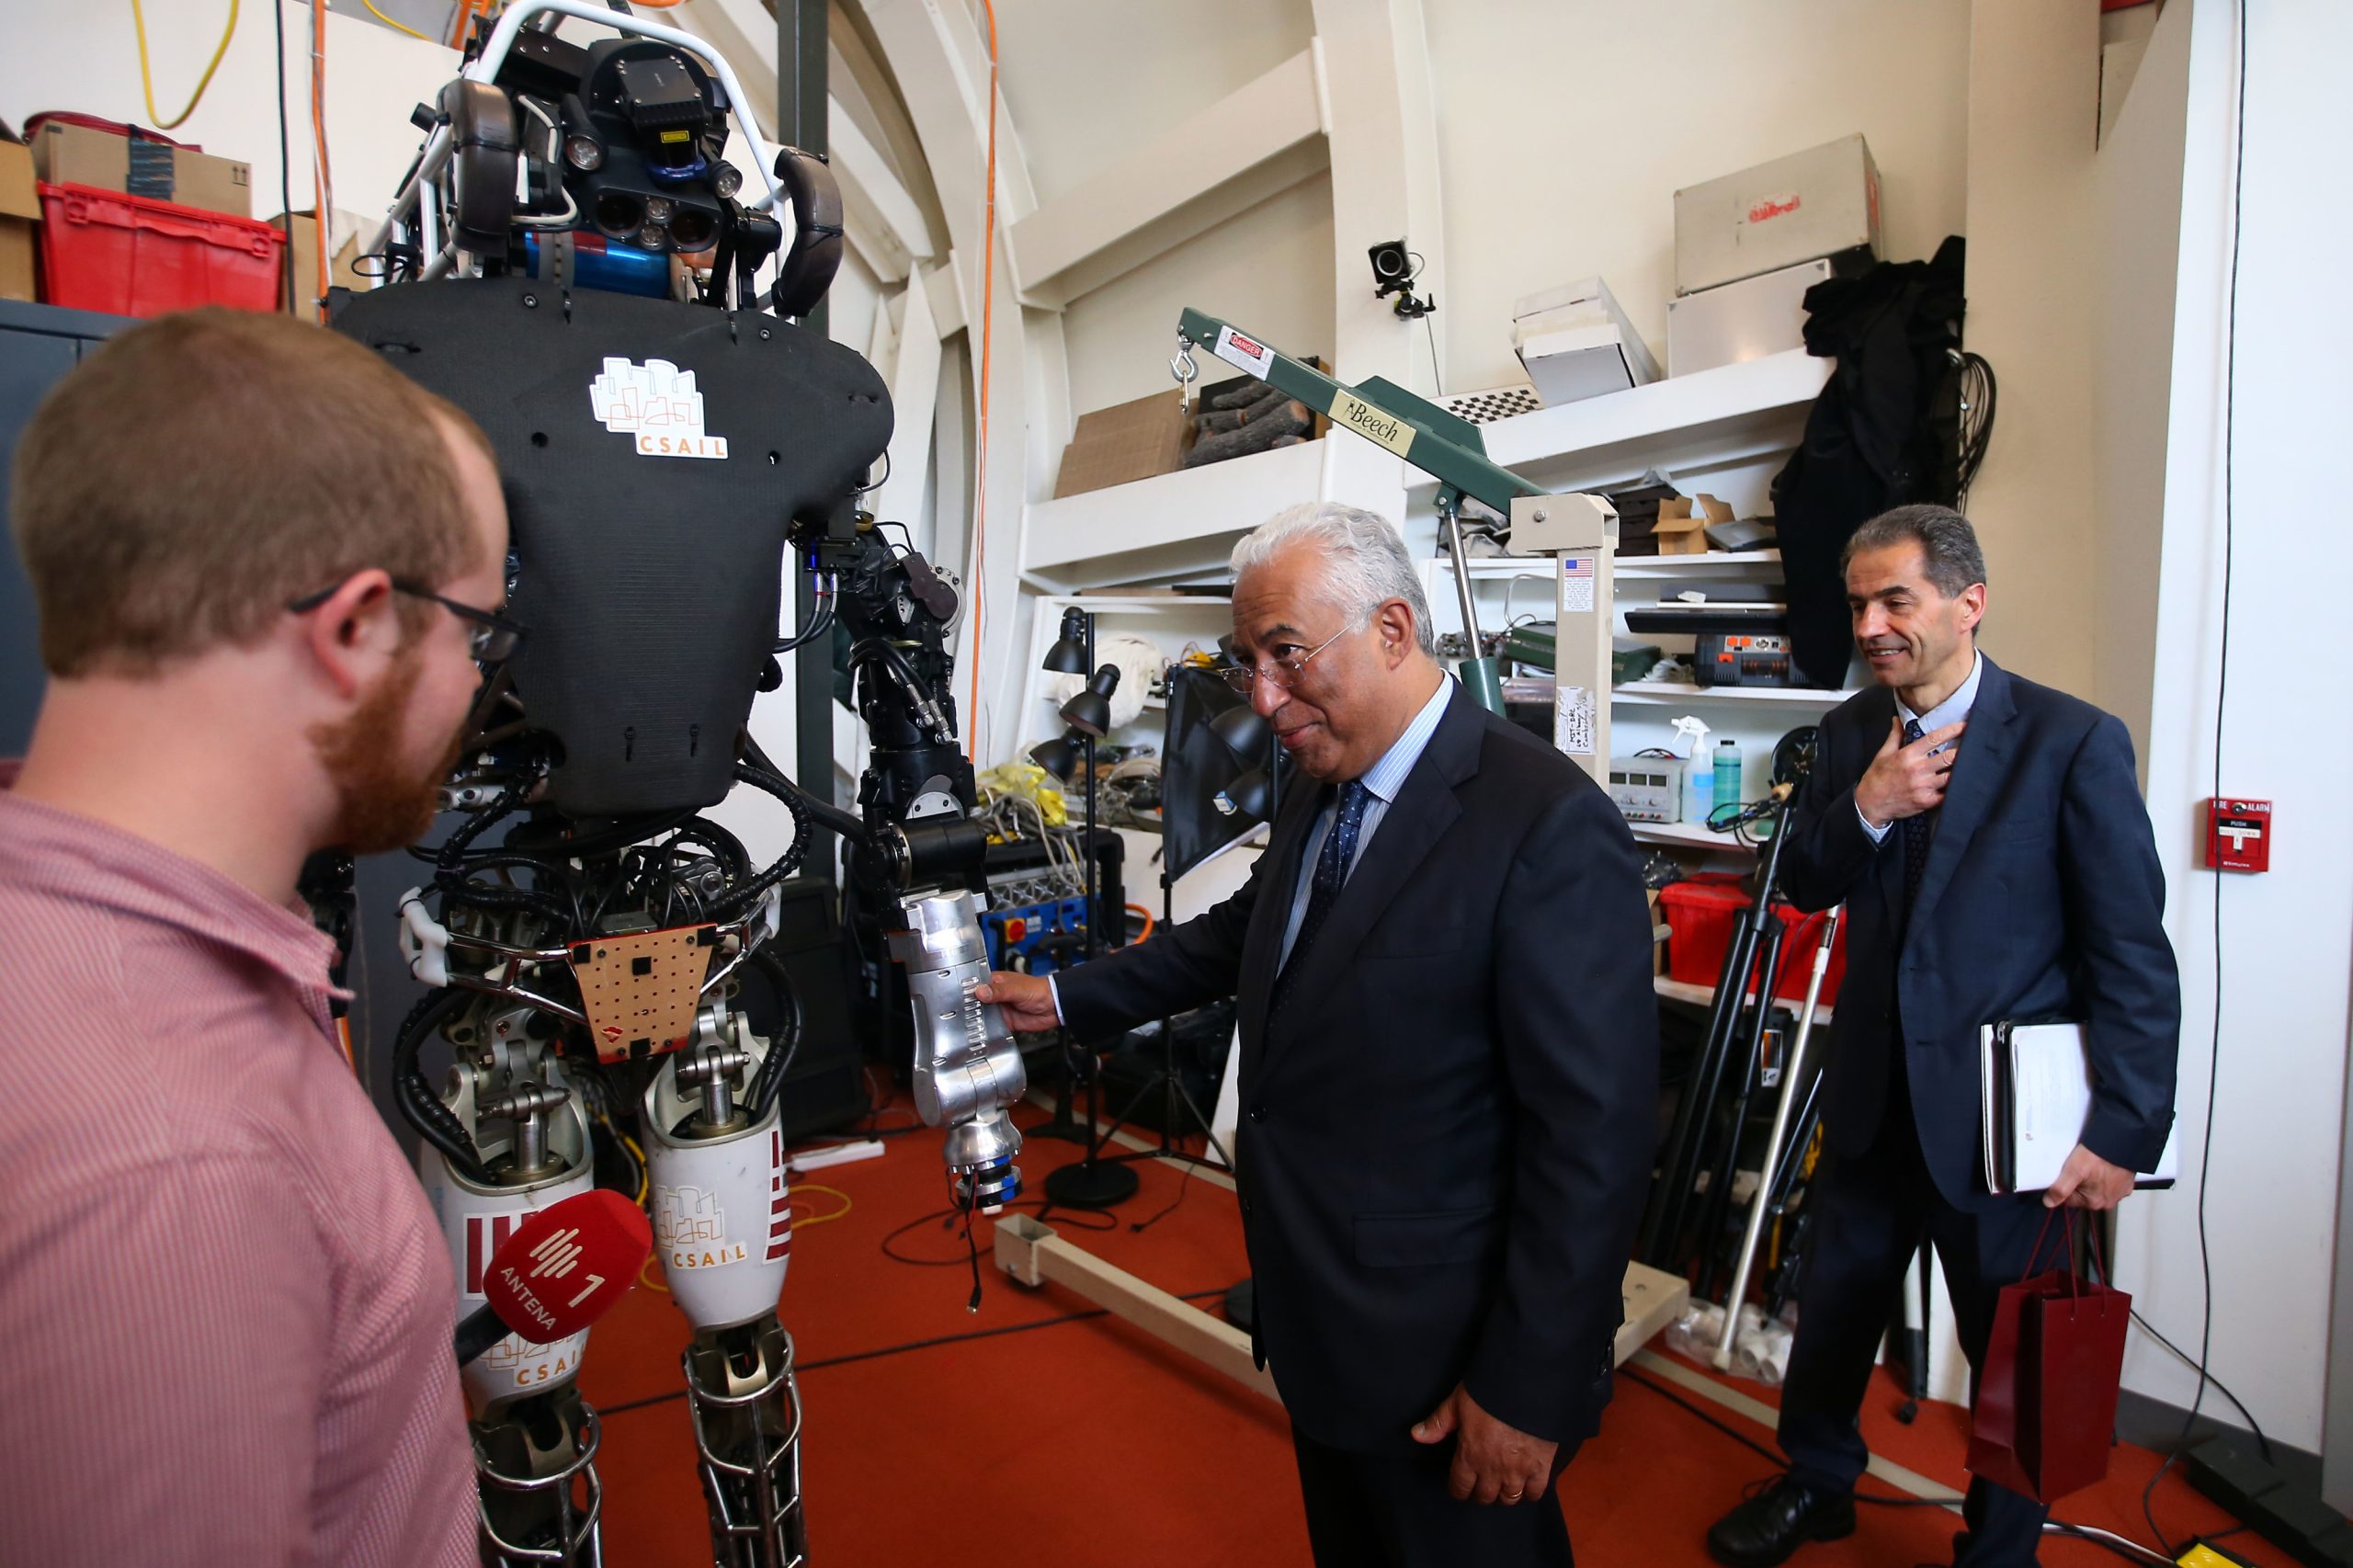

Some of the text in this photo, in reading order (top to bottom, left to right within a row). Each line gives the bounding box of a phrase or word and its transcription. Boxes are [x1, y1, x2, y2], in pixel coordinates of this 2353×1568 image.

[1233, 337, 1260, 356] DANGER
[1350, 403, 1397, 441] Beech
[640, 436, 725, 456] CSAIL
[2247, 803, 2270, 813] ALARM
[674, 1245, 745, 1267] CSAIL
[501, 1267, 606, 1331] ANTENA 1
